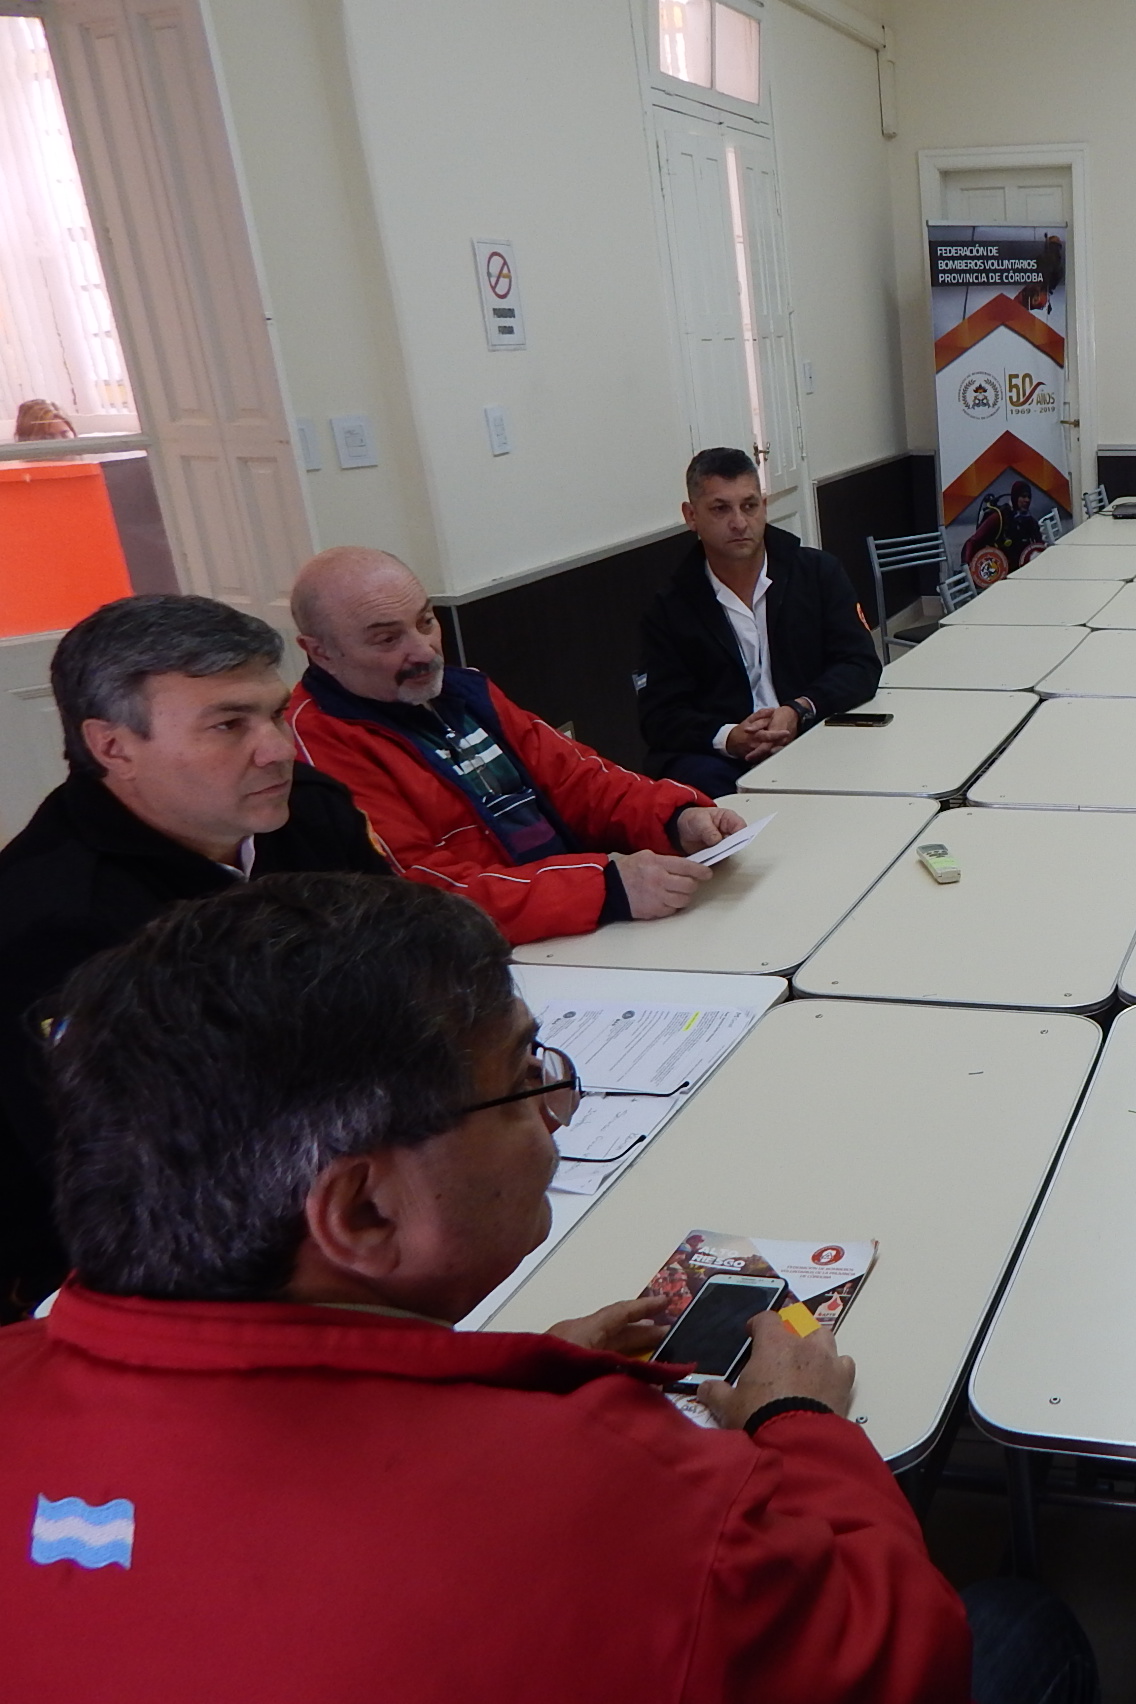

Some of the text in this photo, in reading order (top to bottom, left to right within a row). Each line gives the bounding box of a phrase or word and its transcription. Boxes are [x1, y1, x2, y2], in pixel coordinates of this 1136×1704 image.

[937, 244, 999, 256] FEDERACIÓN DE
[938, 260, 1037, 269] BOMBEROS VOLUNTARIOS
[939, 270, 1044, 283] PROVINCIA DE CÓRDOBA
[1008, 372, 1034, 407] 50
[698, 1246, 739, 1257] ALTO
[692, 1253, 745, 1268] RIESGO
